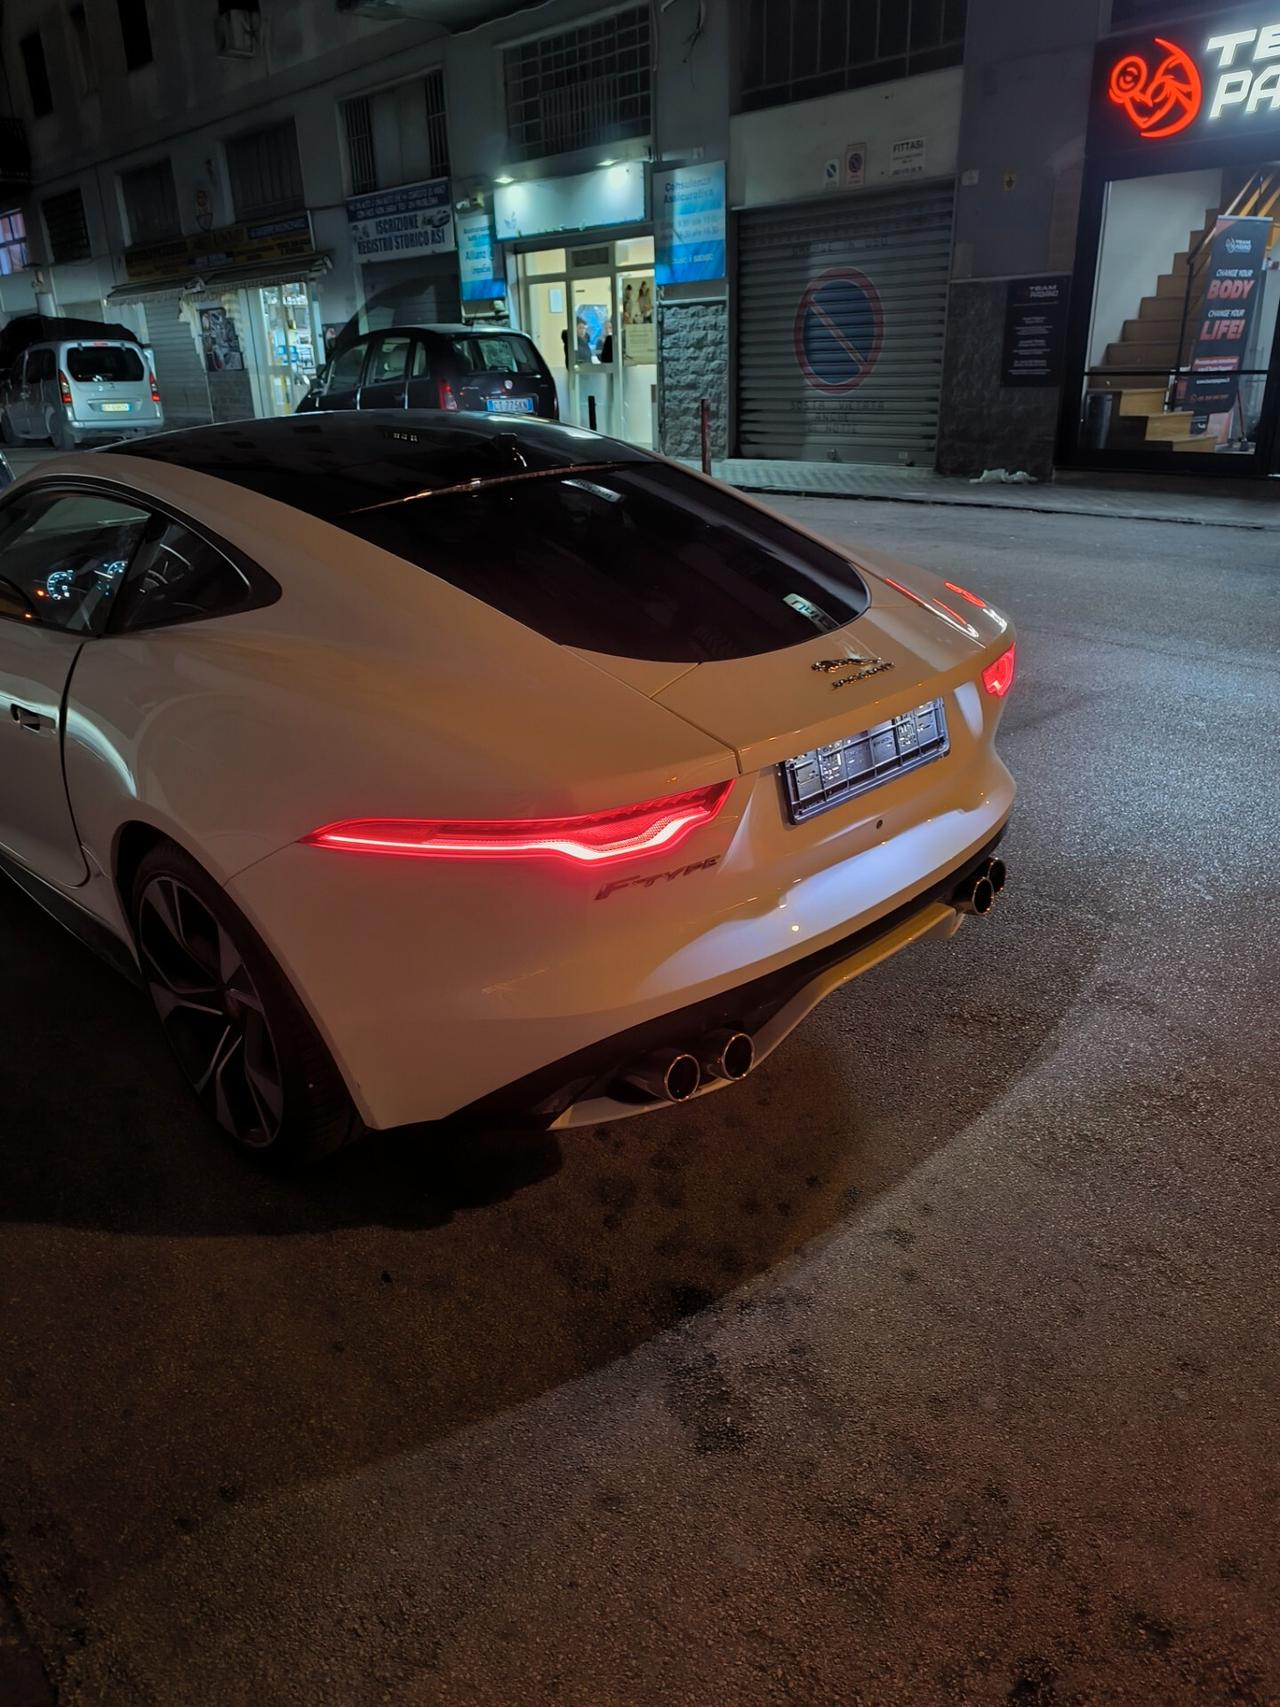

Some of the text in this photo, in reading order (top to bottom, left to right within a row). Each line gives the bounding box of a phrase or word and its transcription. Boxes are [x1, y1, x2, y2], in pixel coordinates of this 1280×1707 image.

[893, 139, 924, 153] FITTASI
[375, 213, 419, 235] ISCRIZIONE
[357, 236, 394, 255] REGISTRO
[394, 231, 430, 249] STORICO
[430, 228, 446, 245] ASI
[1216, 268, 1254, 278] CHANGE YOUR
[1206, 279, 1256, 300] BODY
[1208, 308, 1246, 318] CHANGE YOUR
[1199, 319, 1247, 341] LIFE!
[593, 854, 721, 901] F-TYPE
